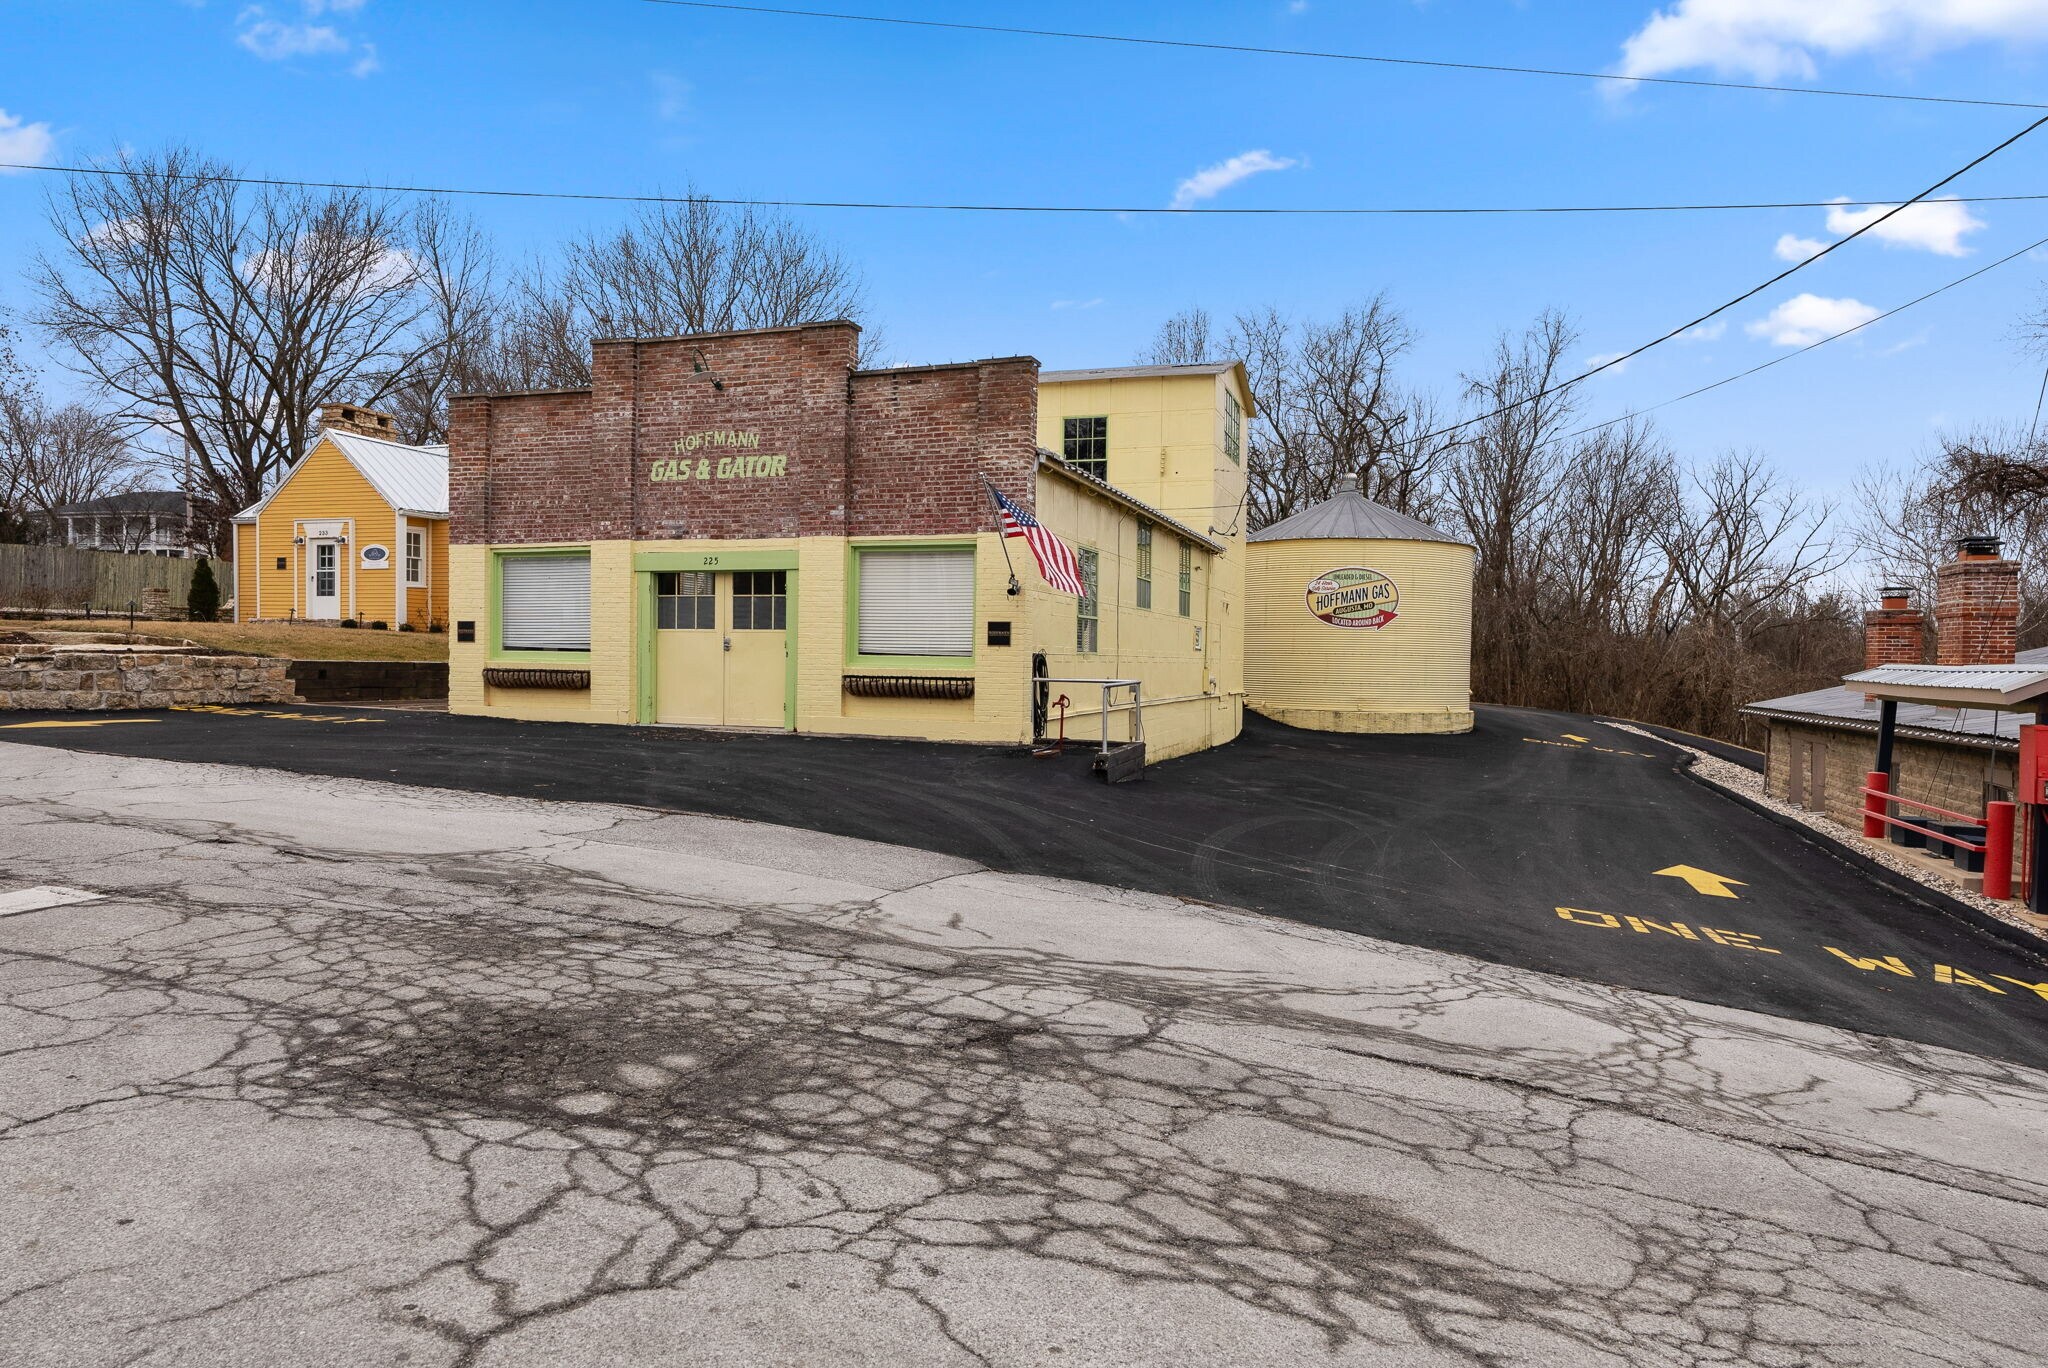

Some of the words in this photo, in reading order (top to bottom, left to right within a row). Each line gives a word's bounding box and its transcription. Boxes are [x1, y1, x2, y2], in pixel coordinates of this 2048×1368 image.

[674, 431, 760, 455] HOFFMANN
[650, 459, 692, 482] GAS
[695, 458, 711, 480] &
[716, 454, 788, 480] GATOR
[703, 556, 719, 566] 225
[1316, 587, 1369, 611] HOFFMANN
[1372, 583, 1390, 599] GAS
[1363, 602, 1374, 610] MO
[1332, 617, 1352, 627] LOCATED
[1352, 618, 1372, 627] AROUND
[1372, 615, 1385, 626] BACK
[1554, 906, 1782, 955] ONE
